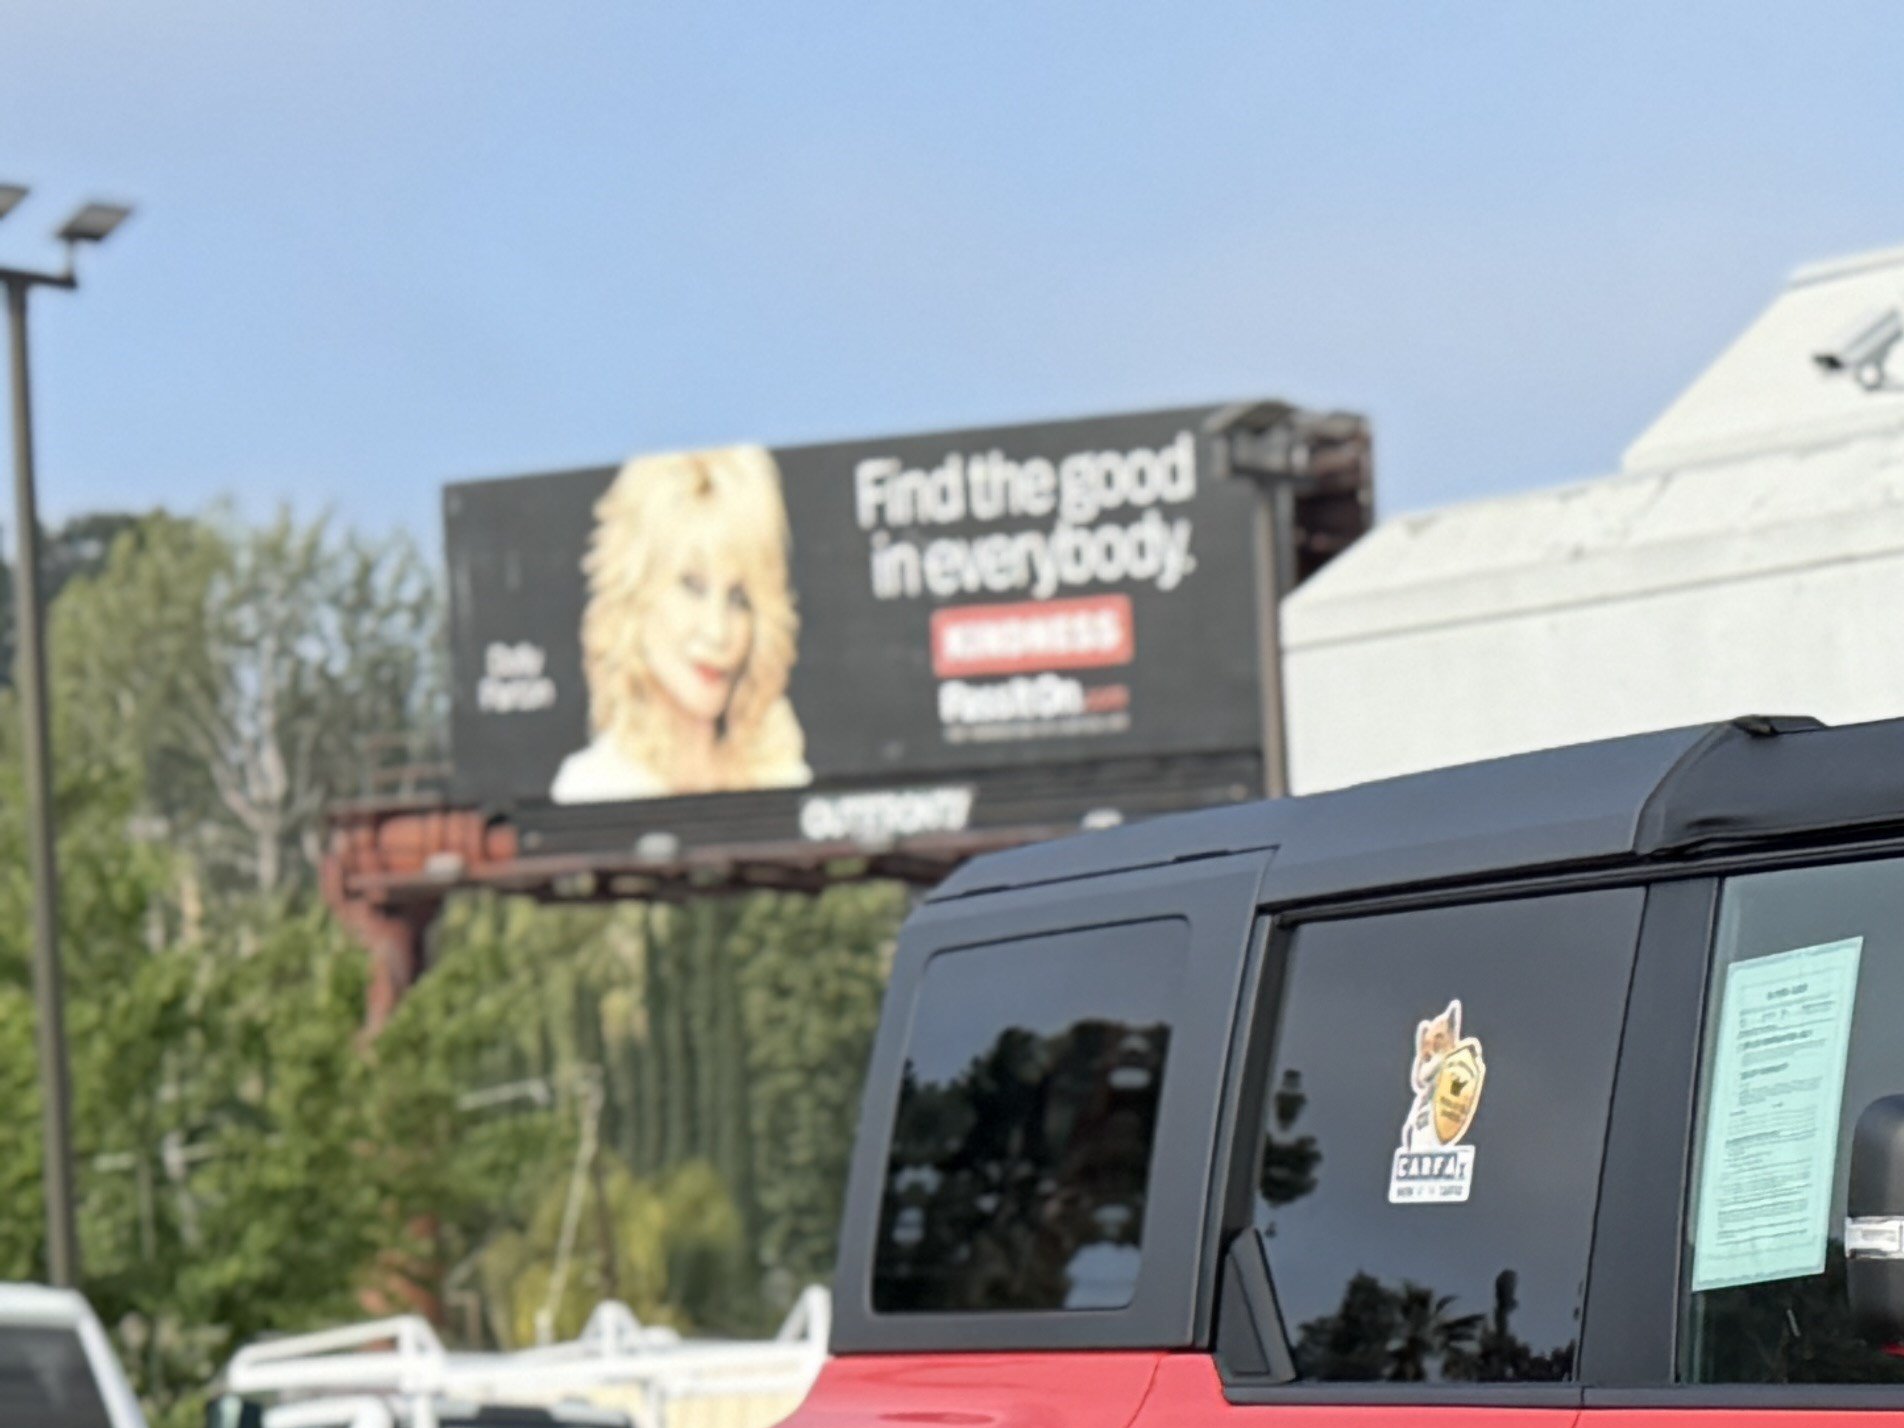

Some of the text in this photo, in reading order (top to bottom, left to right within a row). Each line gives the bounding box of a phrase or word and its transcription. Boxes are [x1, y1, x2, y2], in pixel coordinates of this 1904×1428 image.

[855, 430, 1197, 530] Find the good
[870, 507, 1197, 601] in everybody.
